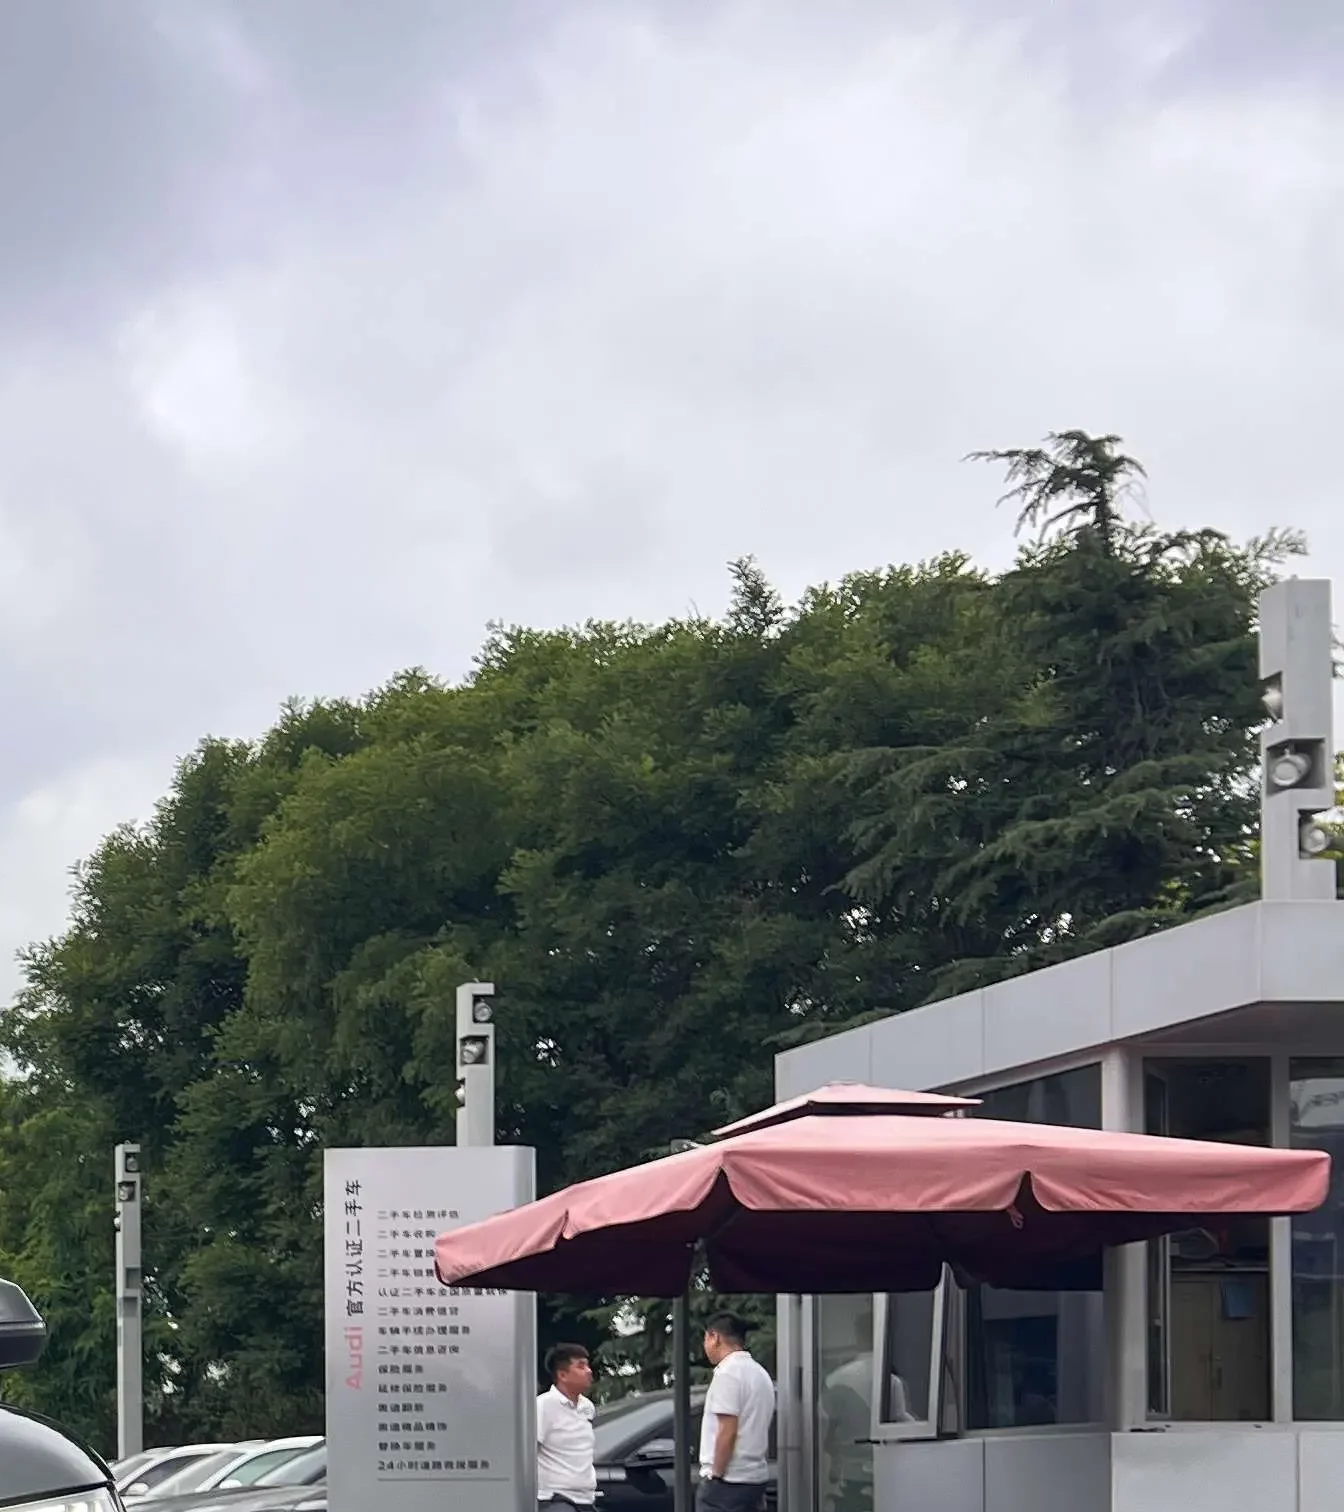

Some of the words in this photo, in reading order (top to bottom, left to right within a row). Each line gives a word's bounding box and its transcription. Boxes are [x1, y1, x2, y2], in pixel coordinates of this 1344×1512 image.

[344, 1180, 364, 1317] 官方认证二手车
[344, 1326, 363, 1390] Audi
